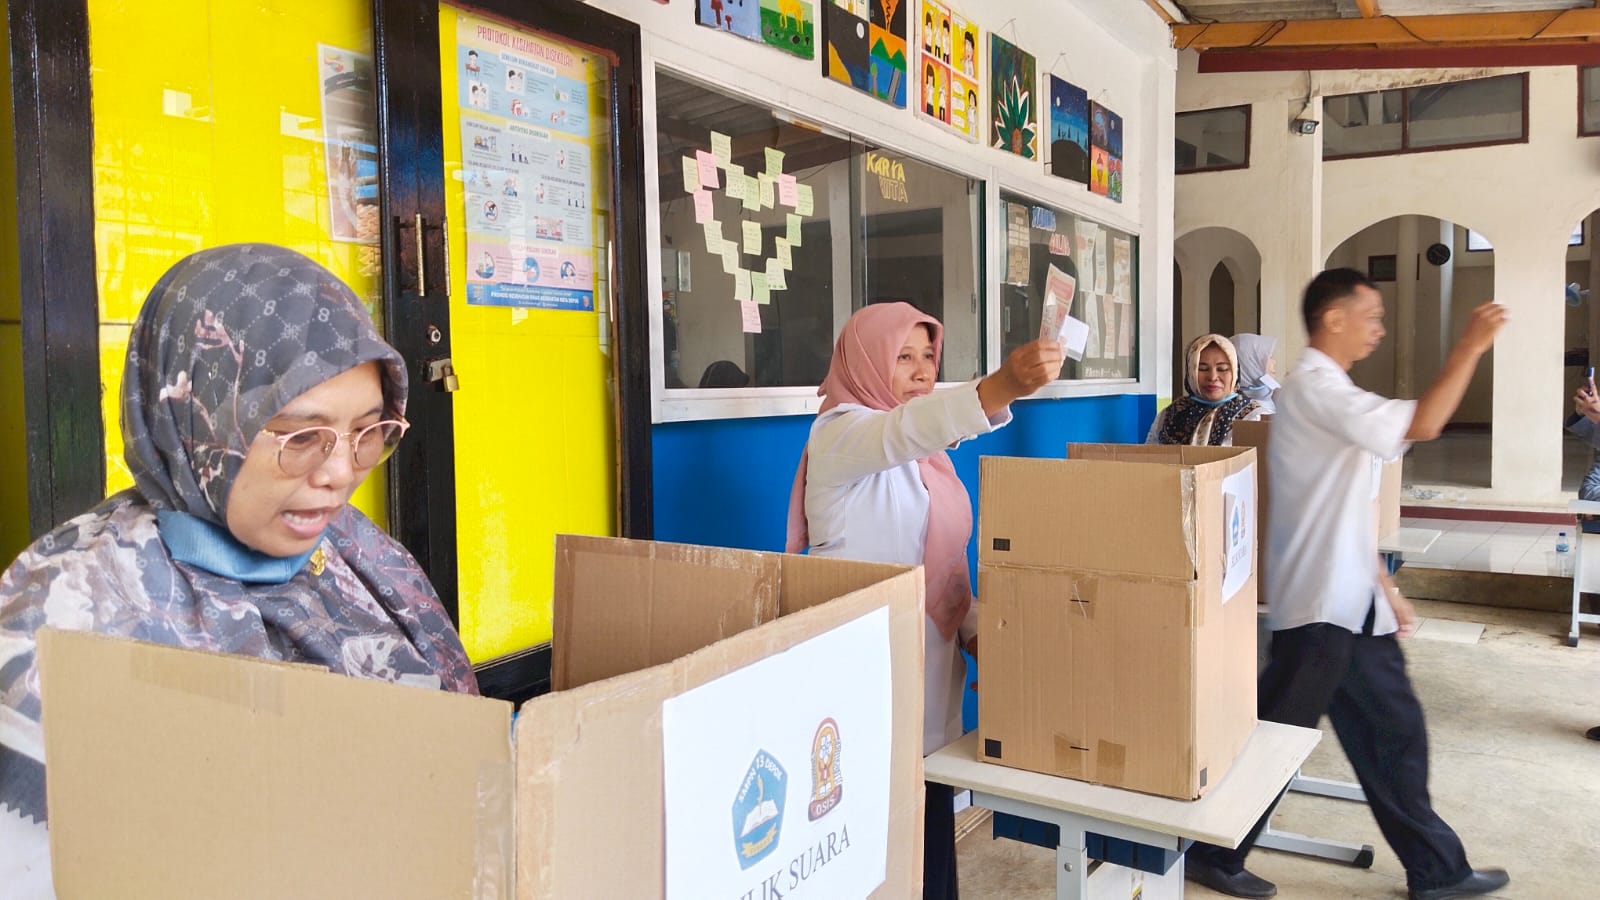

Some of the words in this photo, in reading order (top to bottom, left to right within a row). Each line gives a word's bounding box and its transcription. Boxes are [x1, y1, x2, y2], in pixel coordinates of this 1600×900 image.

[477, 25, 511, 47] PROTOKOL
[866, 152, 906, 183] KARYA
[224, 270, 237, 282] 8
[262, 300, 276, 316] 8
[318, 308, 330, 322] 8
[255, 350, 267, 367] 8
[305, 351, 317, 367] 8
[765, 758, 783, 782] DEPOK
[815, 795, 838, 816] OSIS
[789, 823, 850, 890] SUARA
